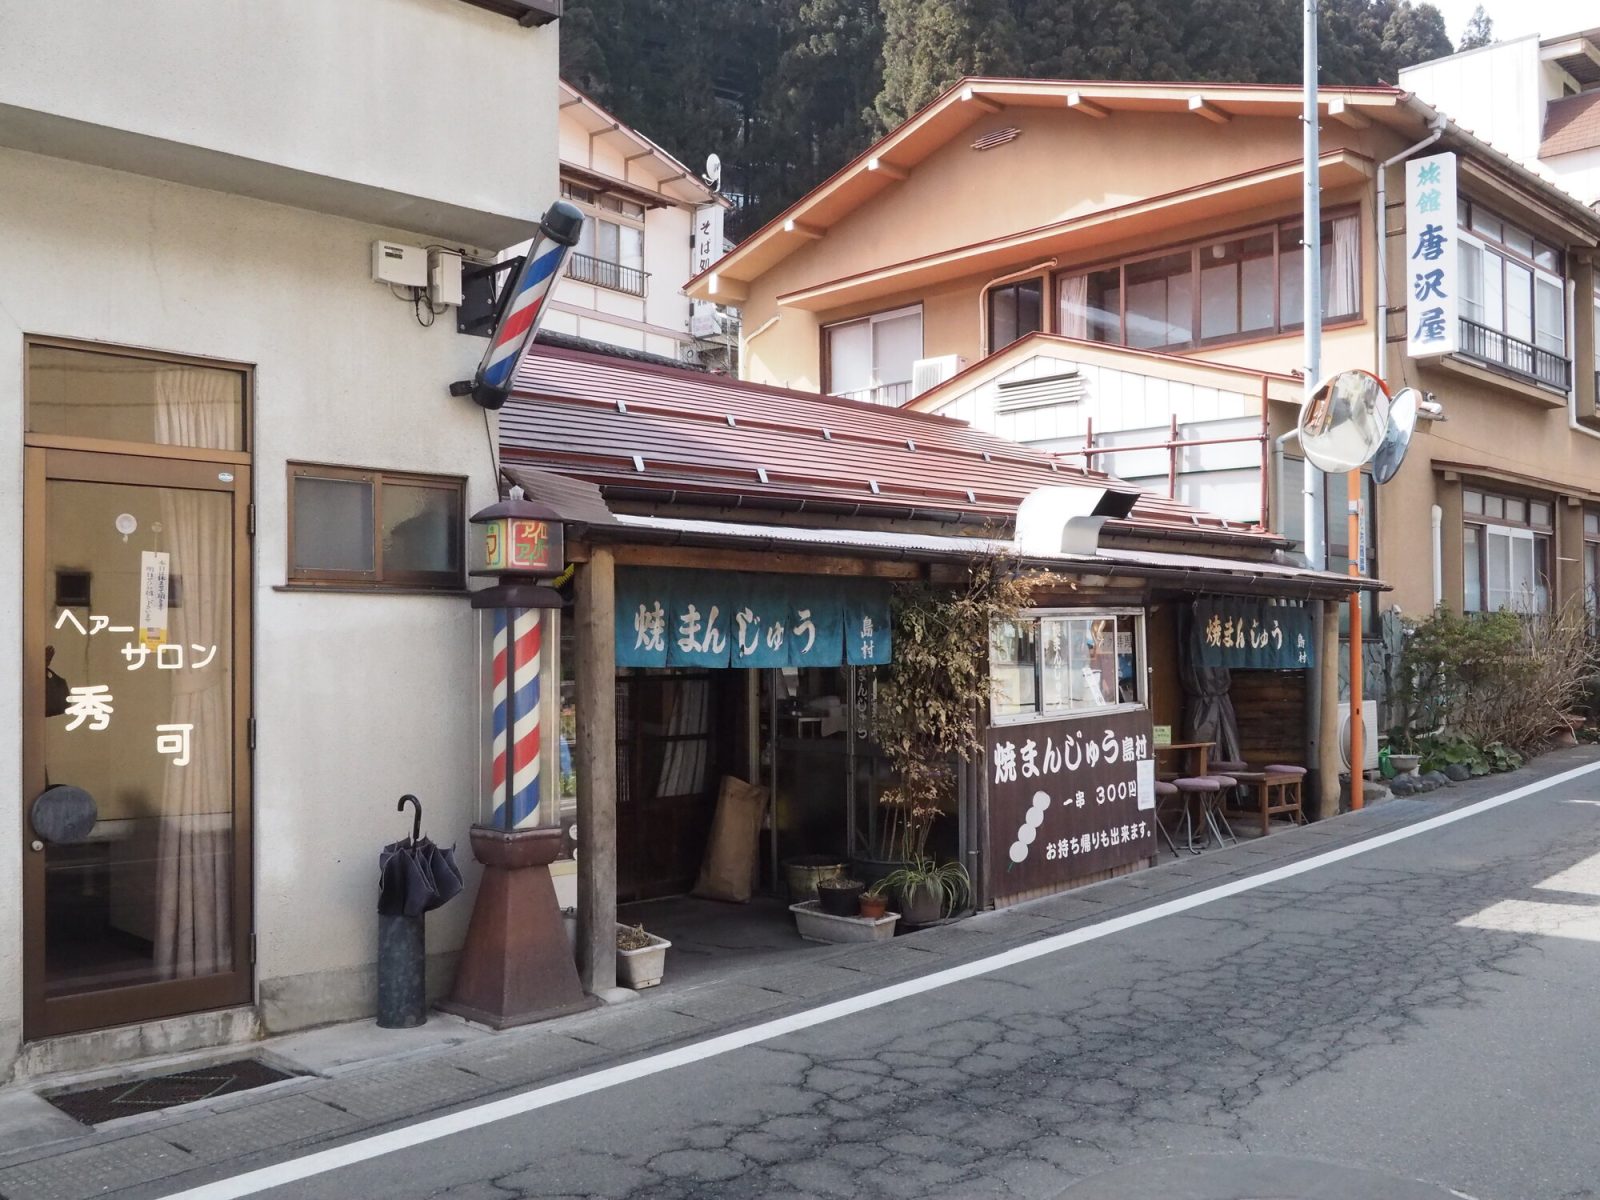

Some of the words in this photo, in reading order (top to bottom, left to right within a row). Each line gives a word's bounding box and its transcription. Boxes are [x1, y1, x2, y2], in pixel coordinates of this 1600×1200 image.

[1416, 161, 1441, 214] 旅館
[1412, 224, 1448, 344] 唐沢屋
[634, 601, 816, 657] 焼まんじゅう
[860, 616, 875, 659] 島村
[1206, 614, 1282, 650] 焼まんじゅう
[121, 642, 216, 670] サロン
[65, 685, 113, 731] 秀
[156, 724, 194, 766] 可
[1063, 790, 1085, 808] 一串
[1096, 781, 1136, 804] 300円
[1046, 821, 1151, 860] お持ち帰りも出来ます。
